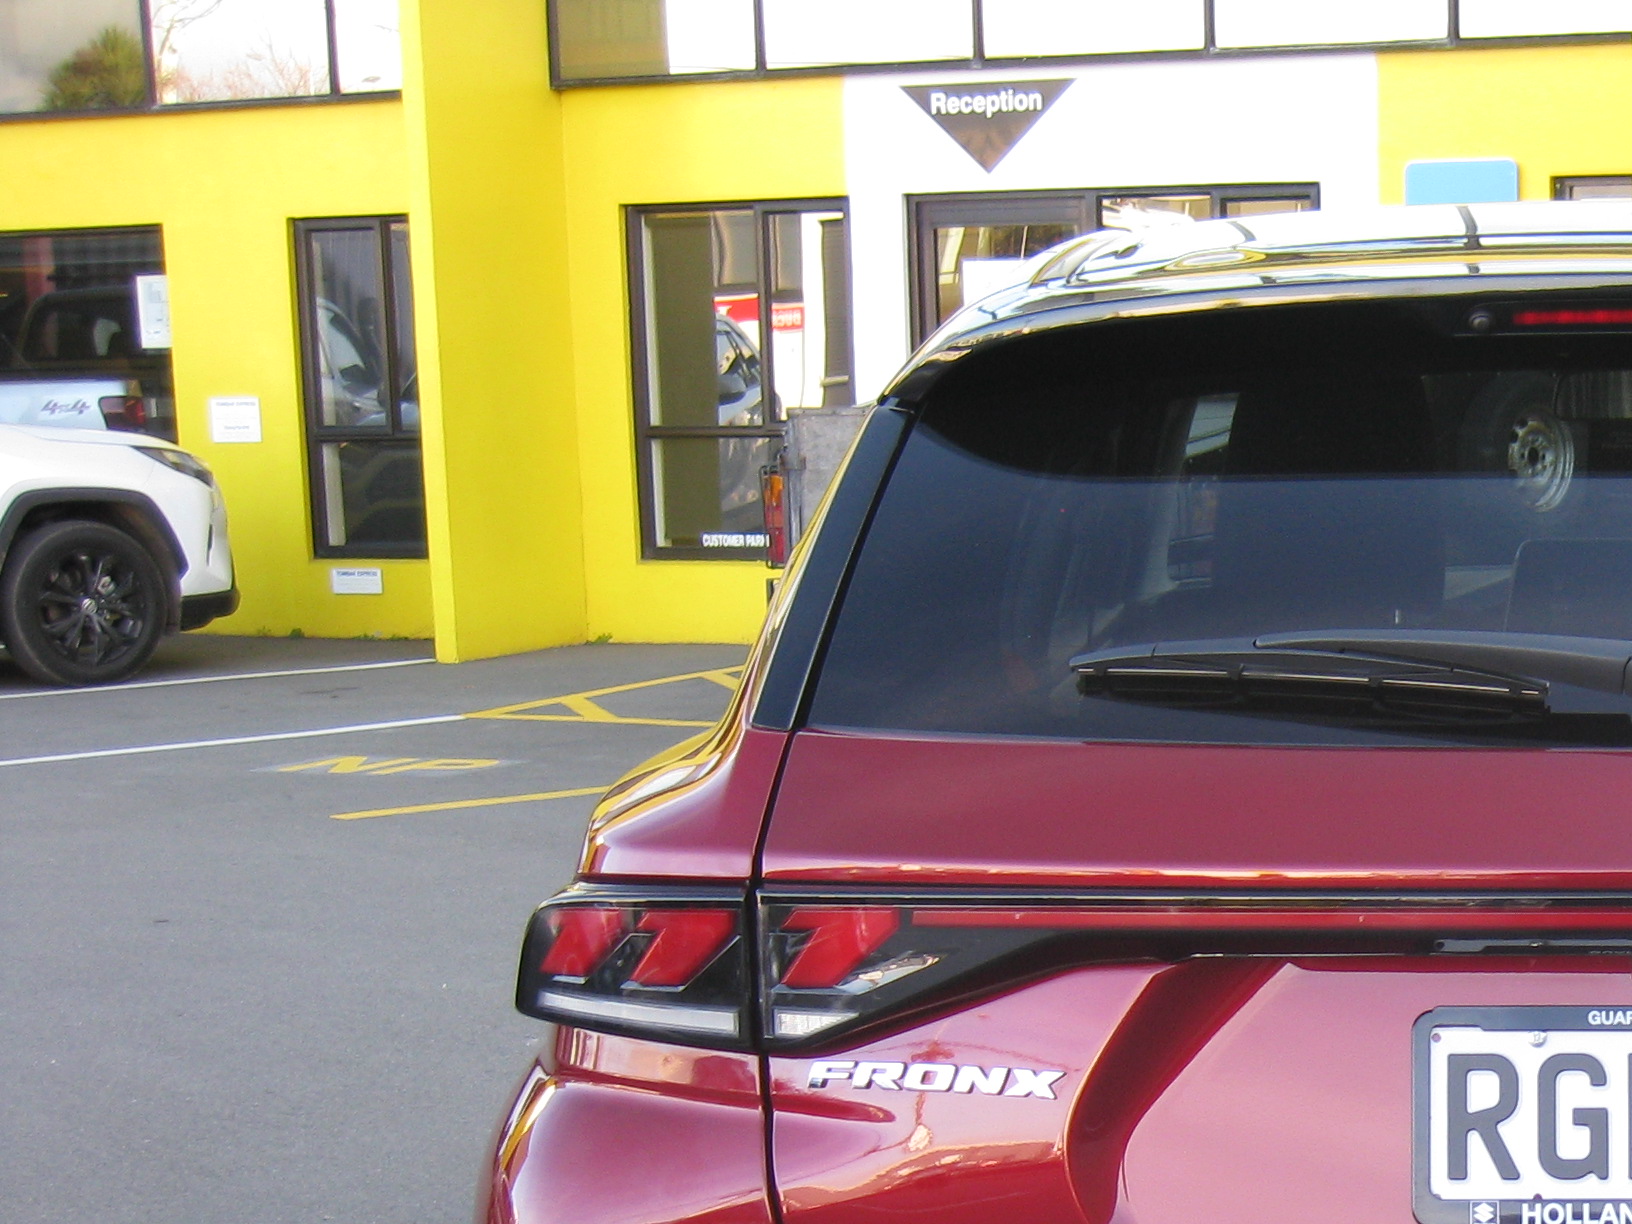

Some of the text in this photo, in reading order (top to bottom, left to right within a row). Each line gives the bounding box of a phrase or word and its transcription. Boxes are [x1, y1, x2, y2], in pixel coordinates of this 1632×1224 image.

[930, 88, 1043, 118] Reception
[40, 399, 91, 415] 4x4
[702, 533, 745, 547] CUSTOMER
[808, 1060, 1067, 1100] FRONX
